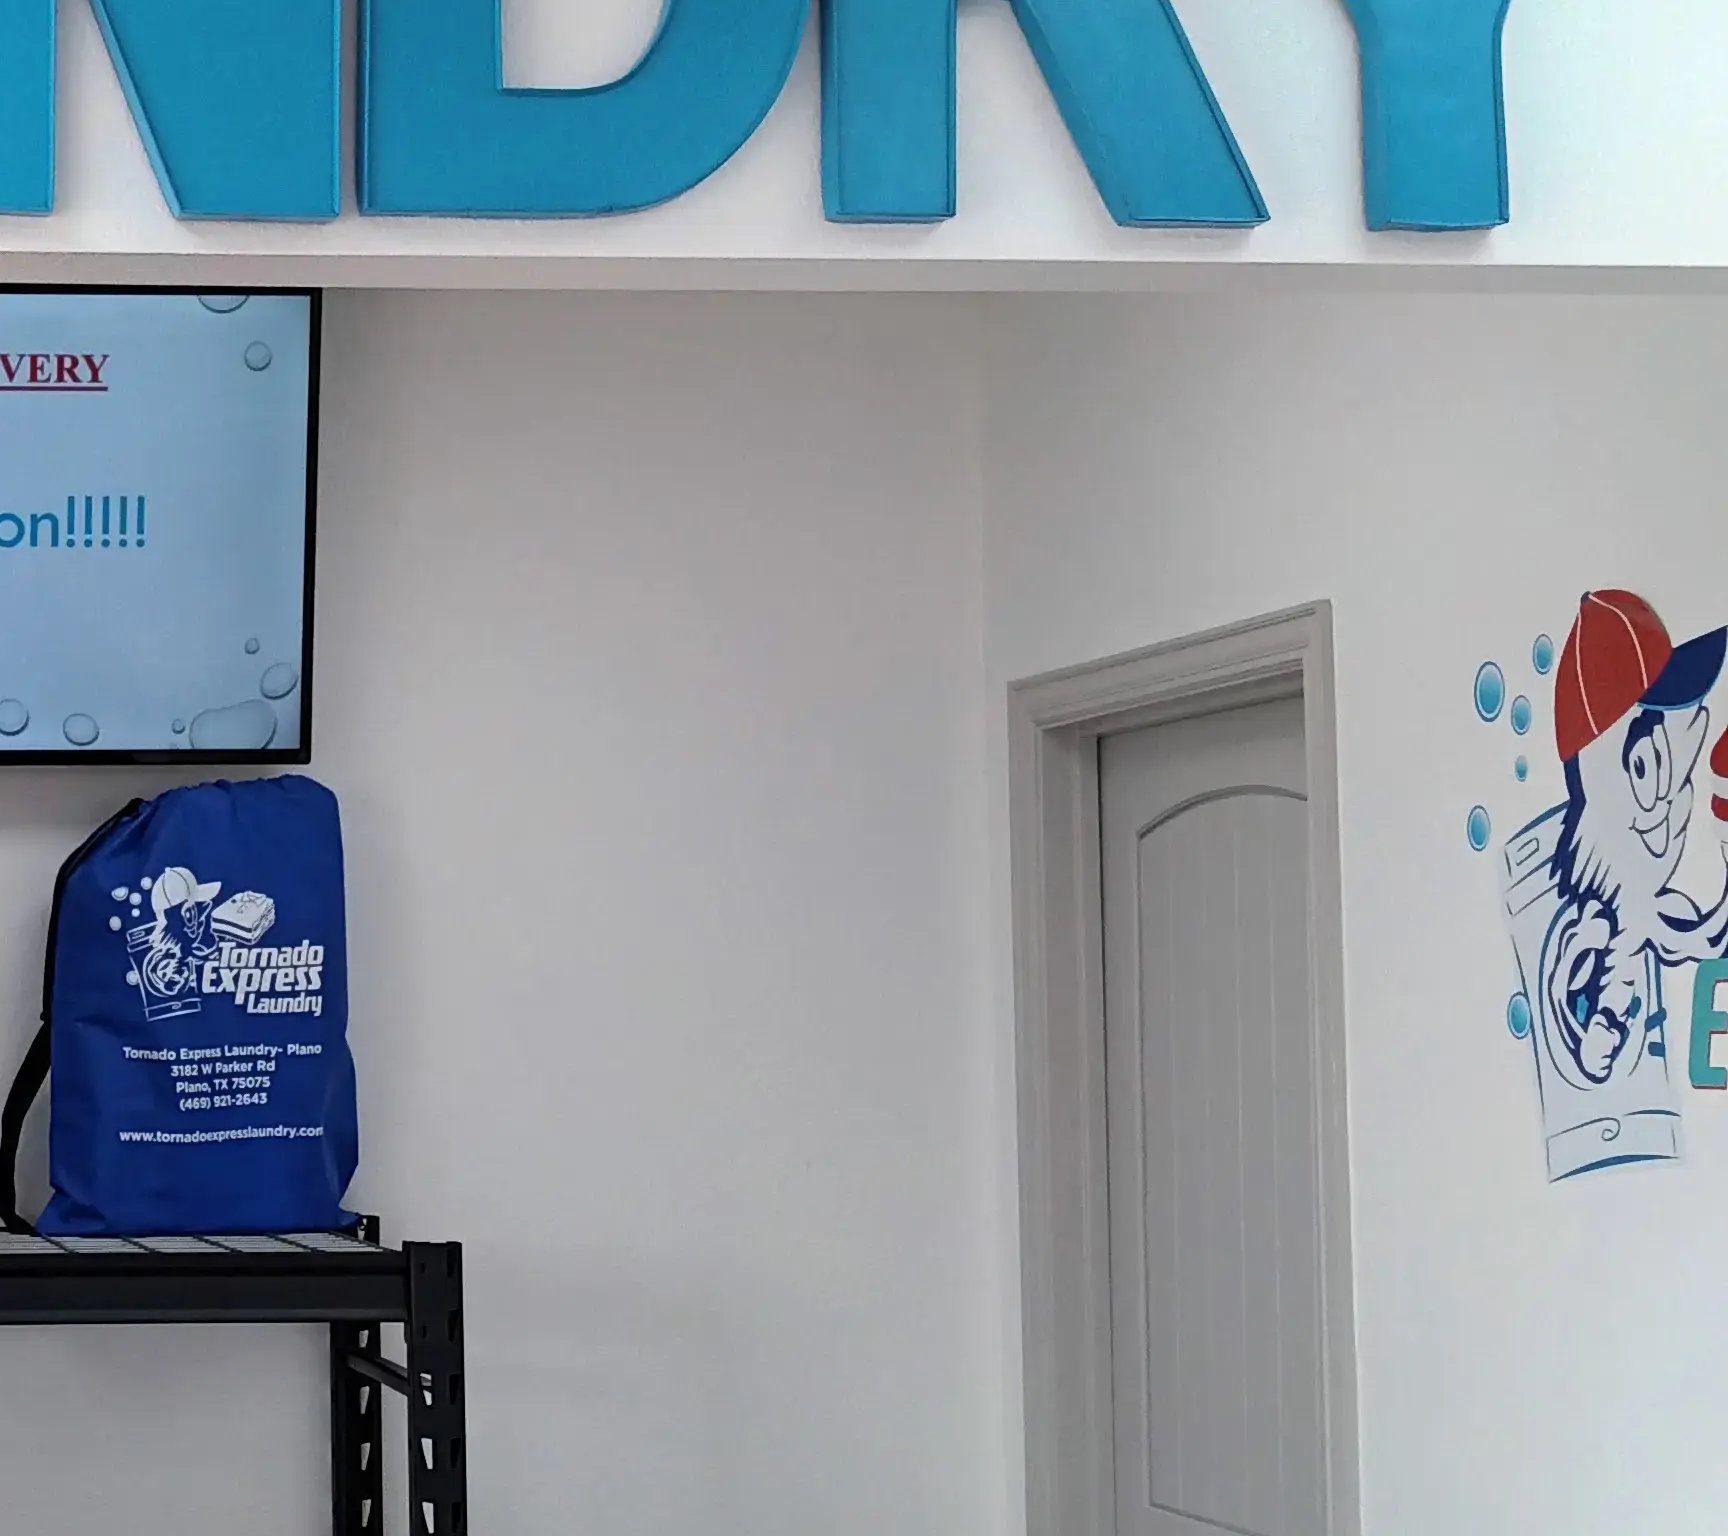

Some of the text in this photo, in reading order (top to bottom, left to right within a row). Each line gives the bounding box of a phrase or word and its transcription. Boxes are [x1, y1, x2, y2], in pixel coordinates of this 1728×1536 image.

[219, 939, 324, 970] Tornado
[202, 961, 323, 1005] Express
[246, 992, 323, 1016] Laundry
[122, 1043, 322, 1061] Tornado Express Laundry- Plano
[170, 1060, 276, 1077] 3182 W Parker Rd
[176, 1076, 271, 1095] Plano, TX 75075
[179, 1092, 268, 1112] (469) 921-2643
